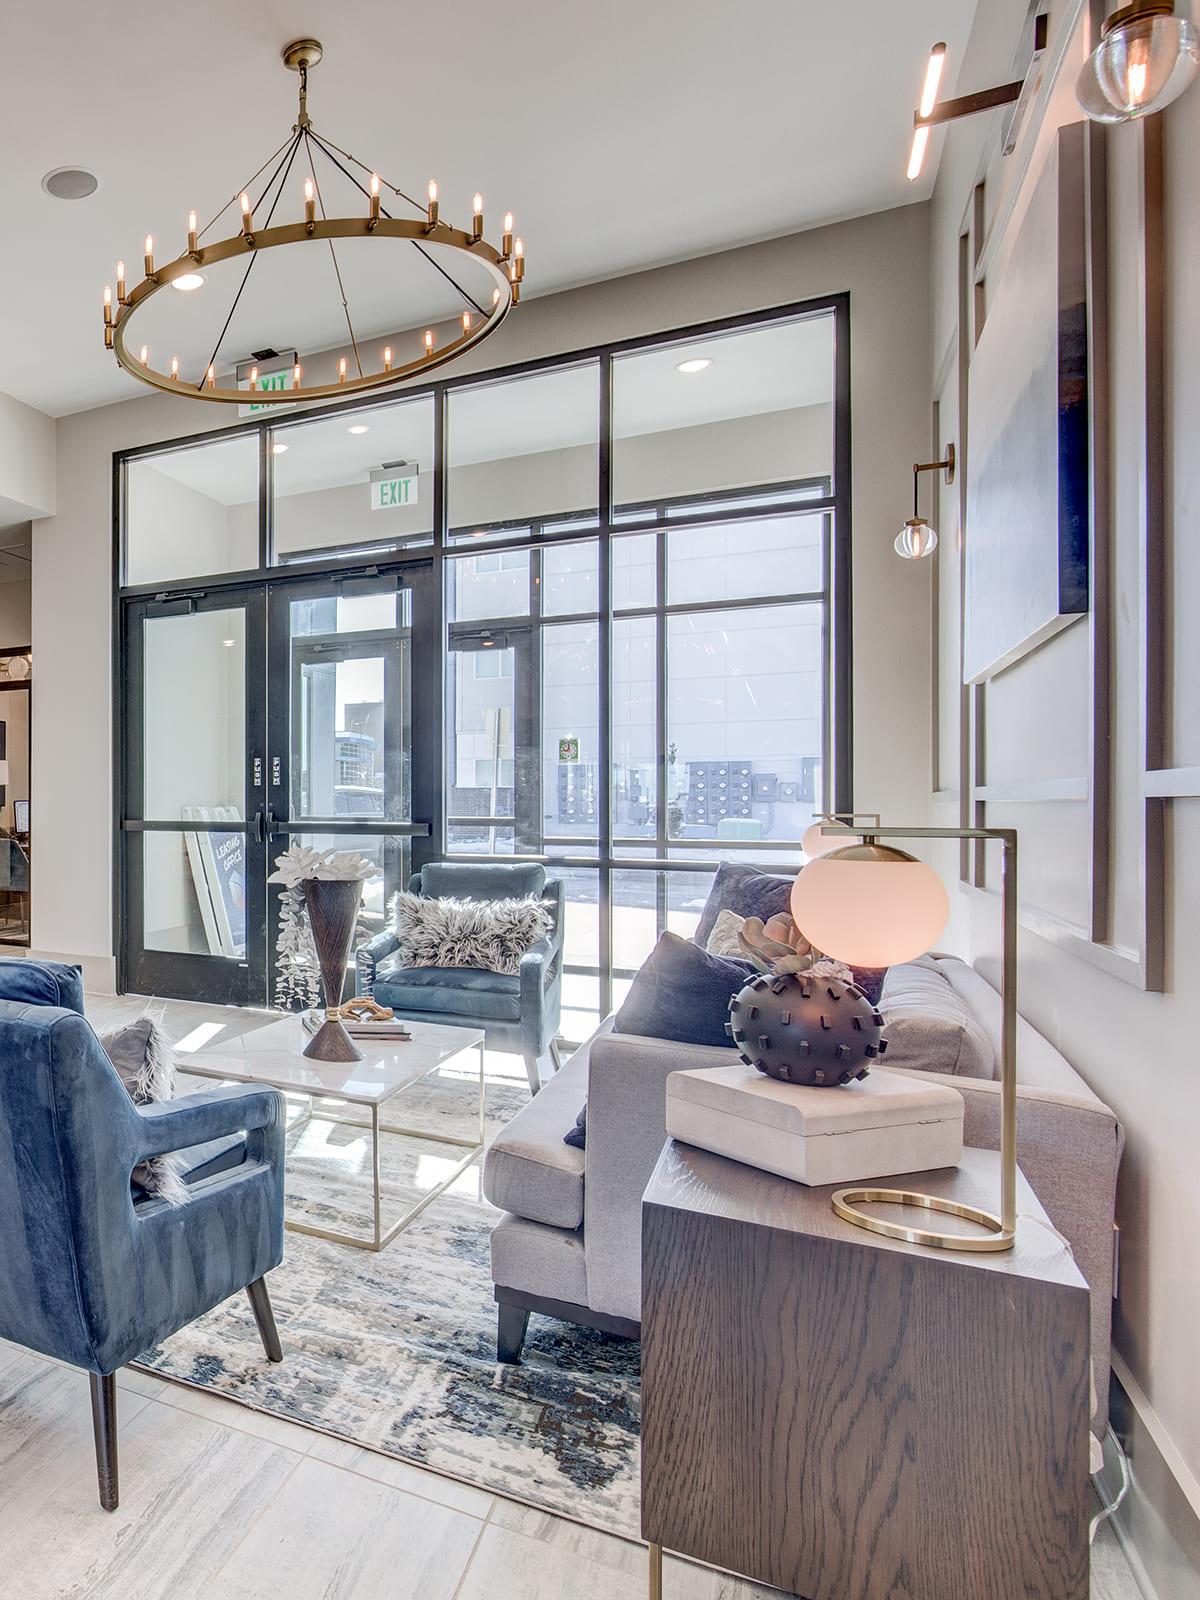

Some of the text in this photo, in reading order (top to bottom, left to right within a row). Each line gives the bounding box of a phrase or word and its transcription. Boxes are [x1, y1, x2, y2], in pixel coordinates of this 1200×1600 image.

[250, 373, 287, 411] XIT
[380, 479, 410, 505] EXIT
[215, 835, 240, 860] LEASING
[224, 849, 242, 871] OFFICE
